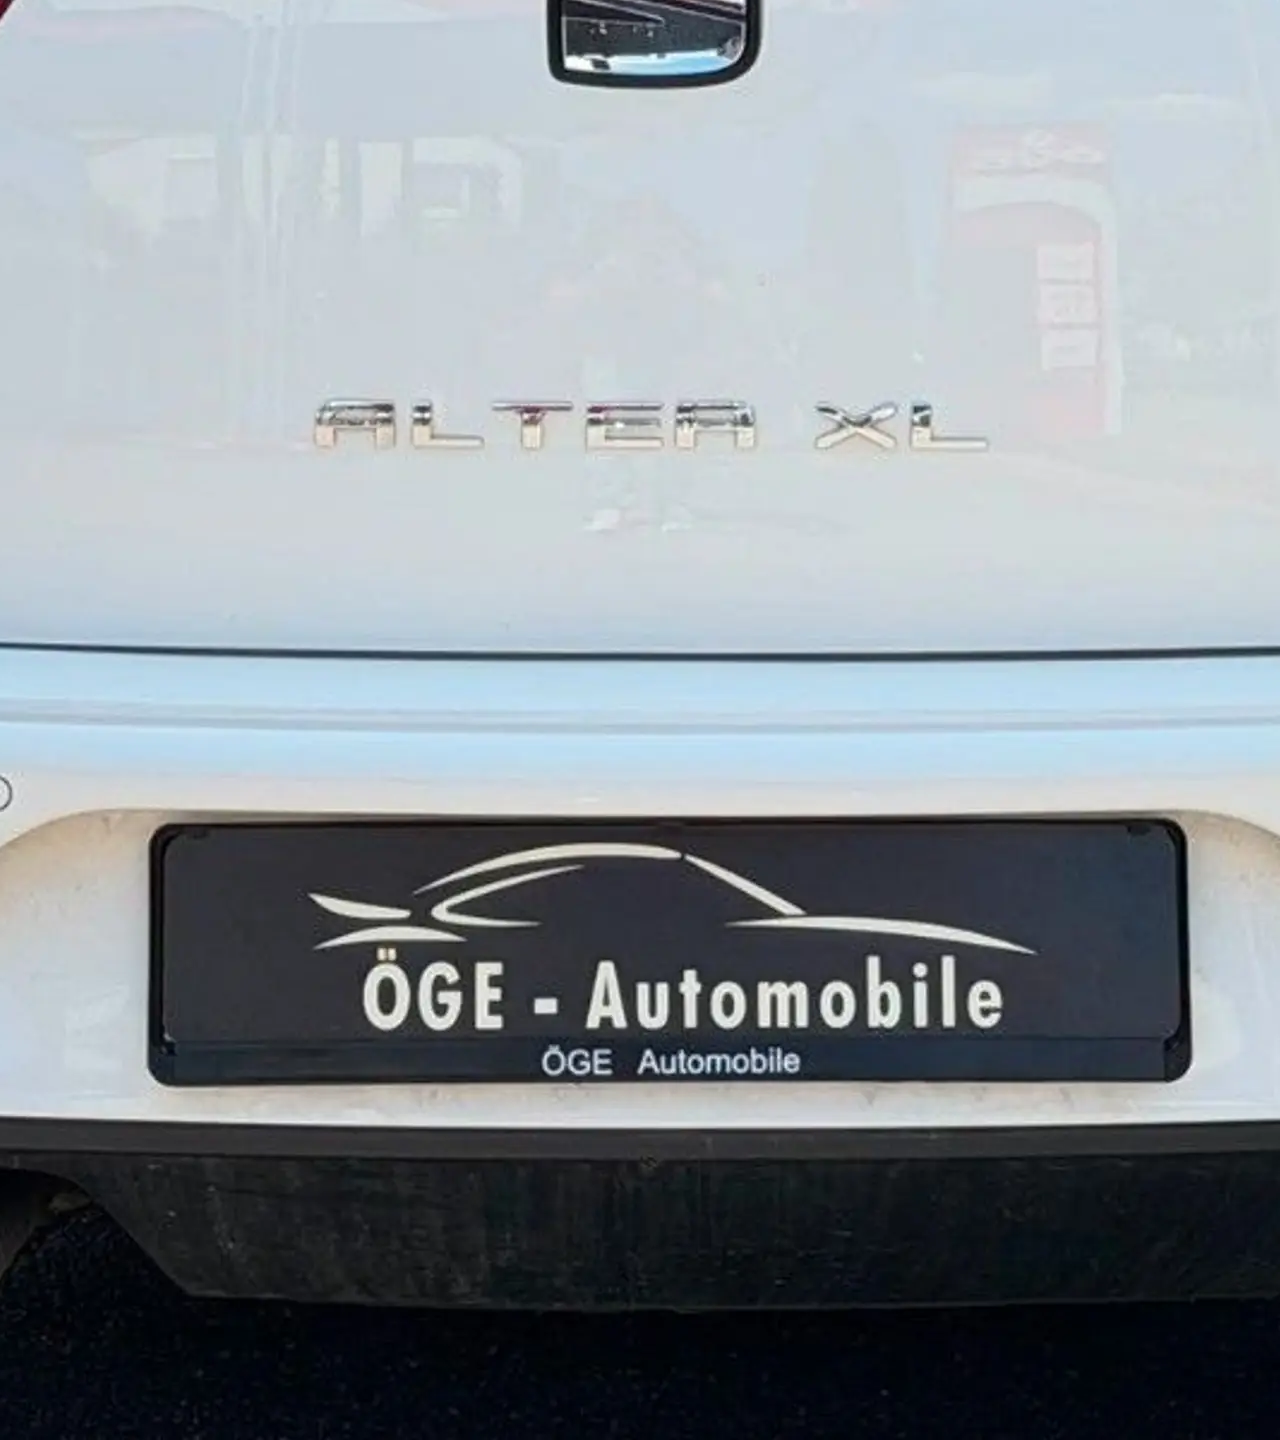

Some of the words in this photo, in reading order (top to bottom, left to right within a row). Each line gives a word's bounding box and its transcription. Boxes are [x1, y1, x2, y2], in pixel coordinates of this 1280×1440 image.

[314, 399, 756, 449] ALTEA
[814, 400, 990, 450] XL
[363, 947, 504, 1031] ÖGE
[585, 955, 1004, 1030] Automobile
[541, 1045, 613, 1076] ÖGE
[637, 1048, 801, 1075] Automobile
